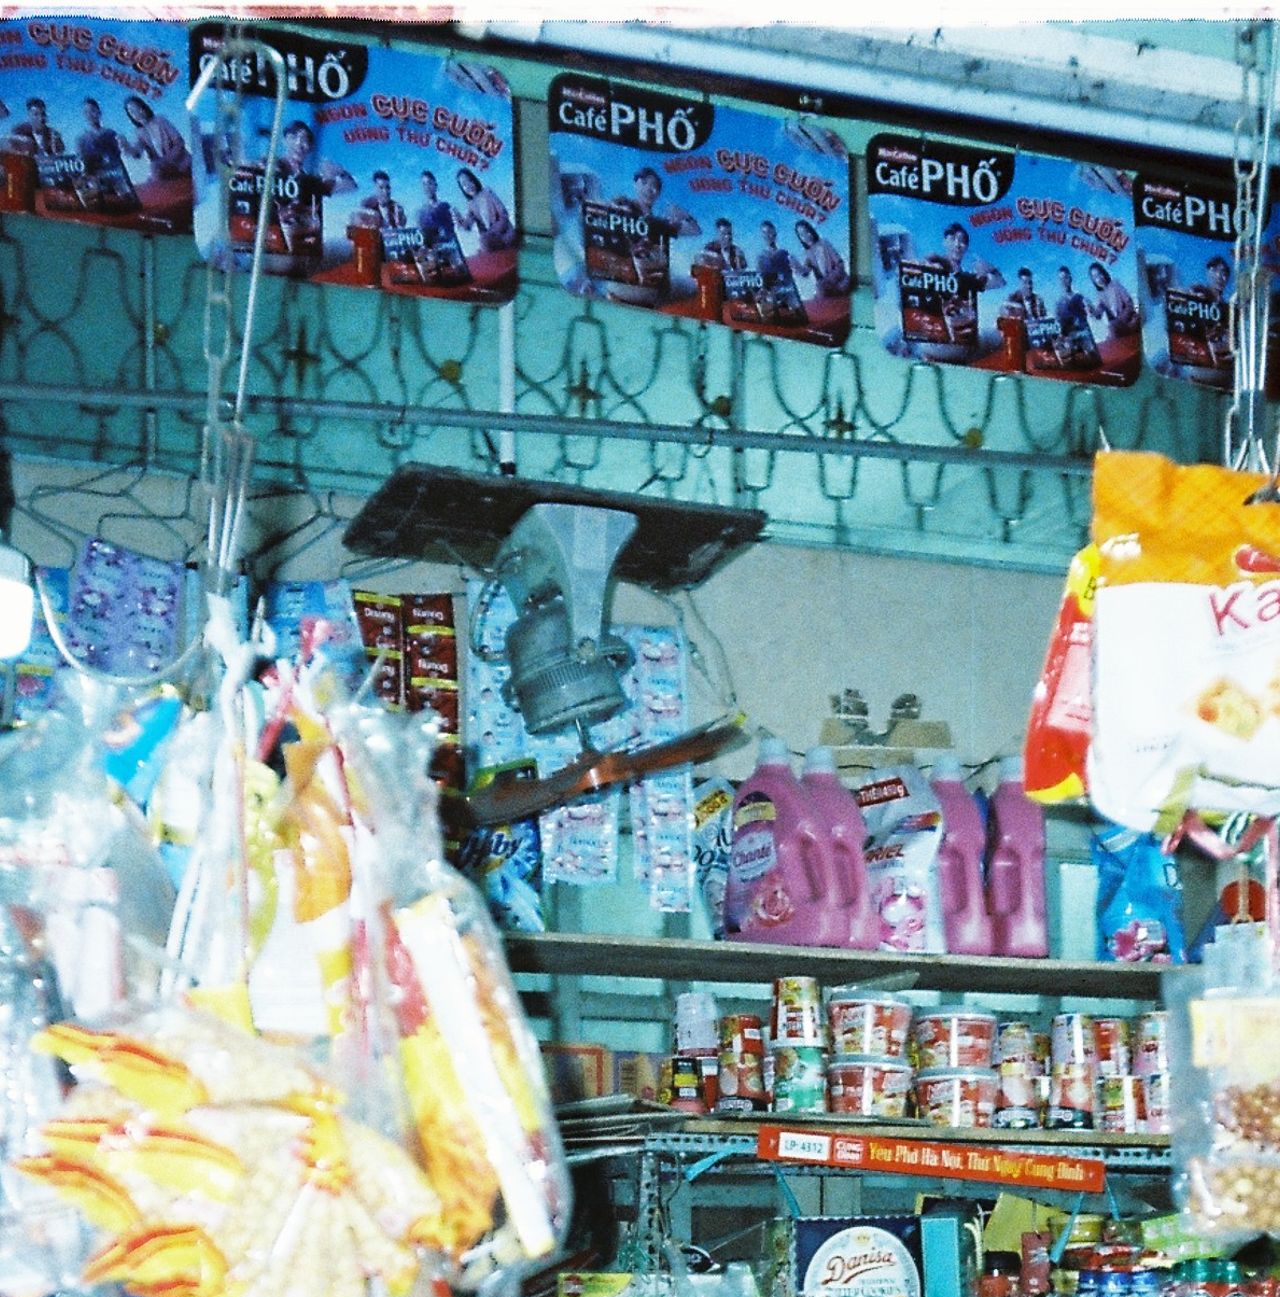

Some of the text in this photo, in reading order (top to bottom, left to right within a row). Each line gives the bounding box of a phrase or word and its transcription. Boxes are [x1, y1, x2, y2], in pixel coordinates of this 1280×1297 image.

[558, 100, 607, 131] Café
[875, 157, 1000, 203] Café PHỐ
[1141, 197, 1182, 224] Café
